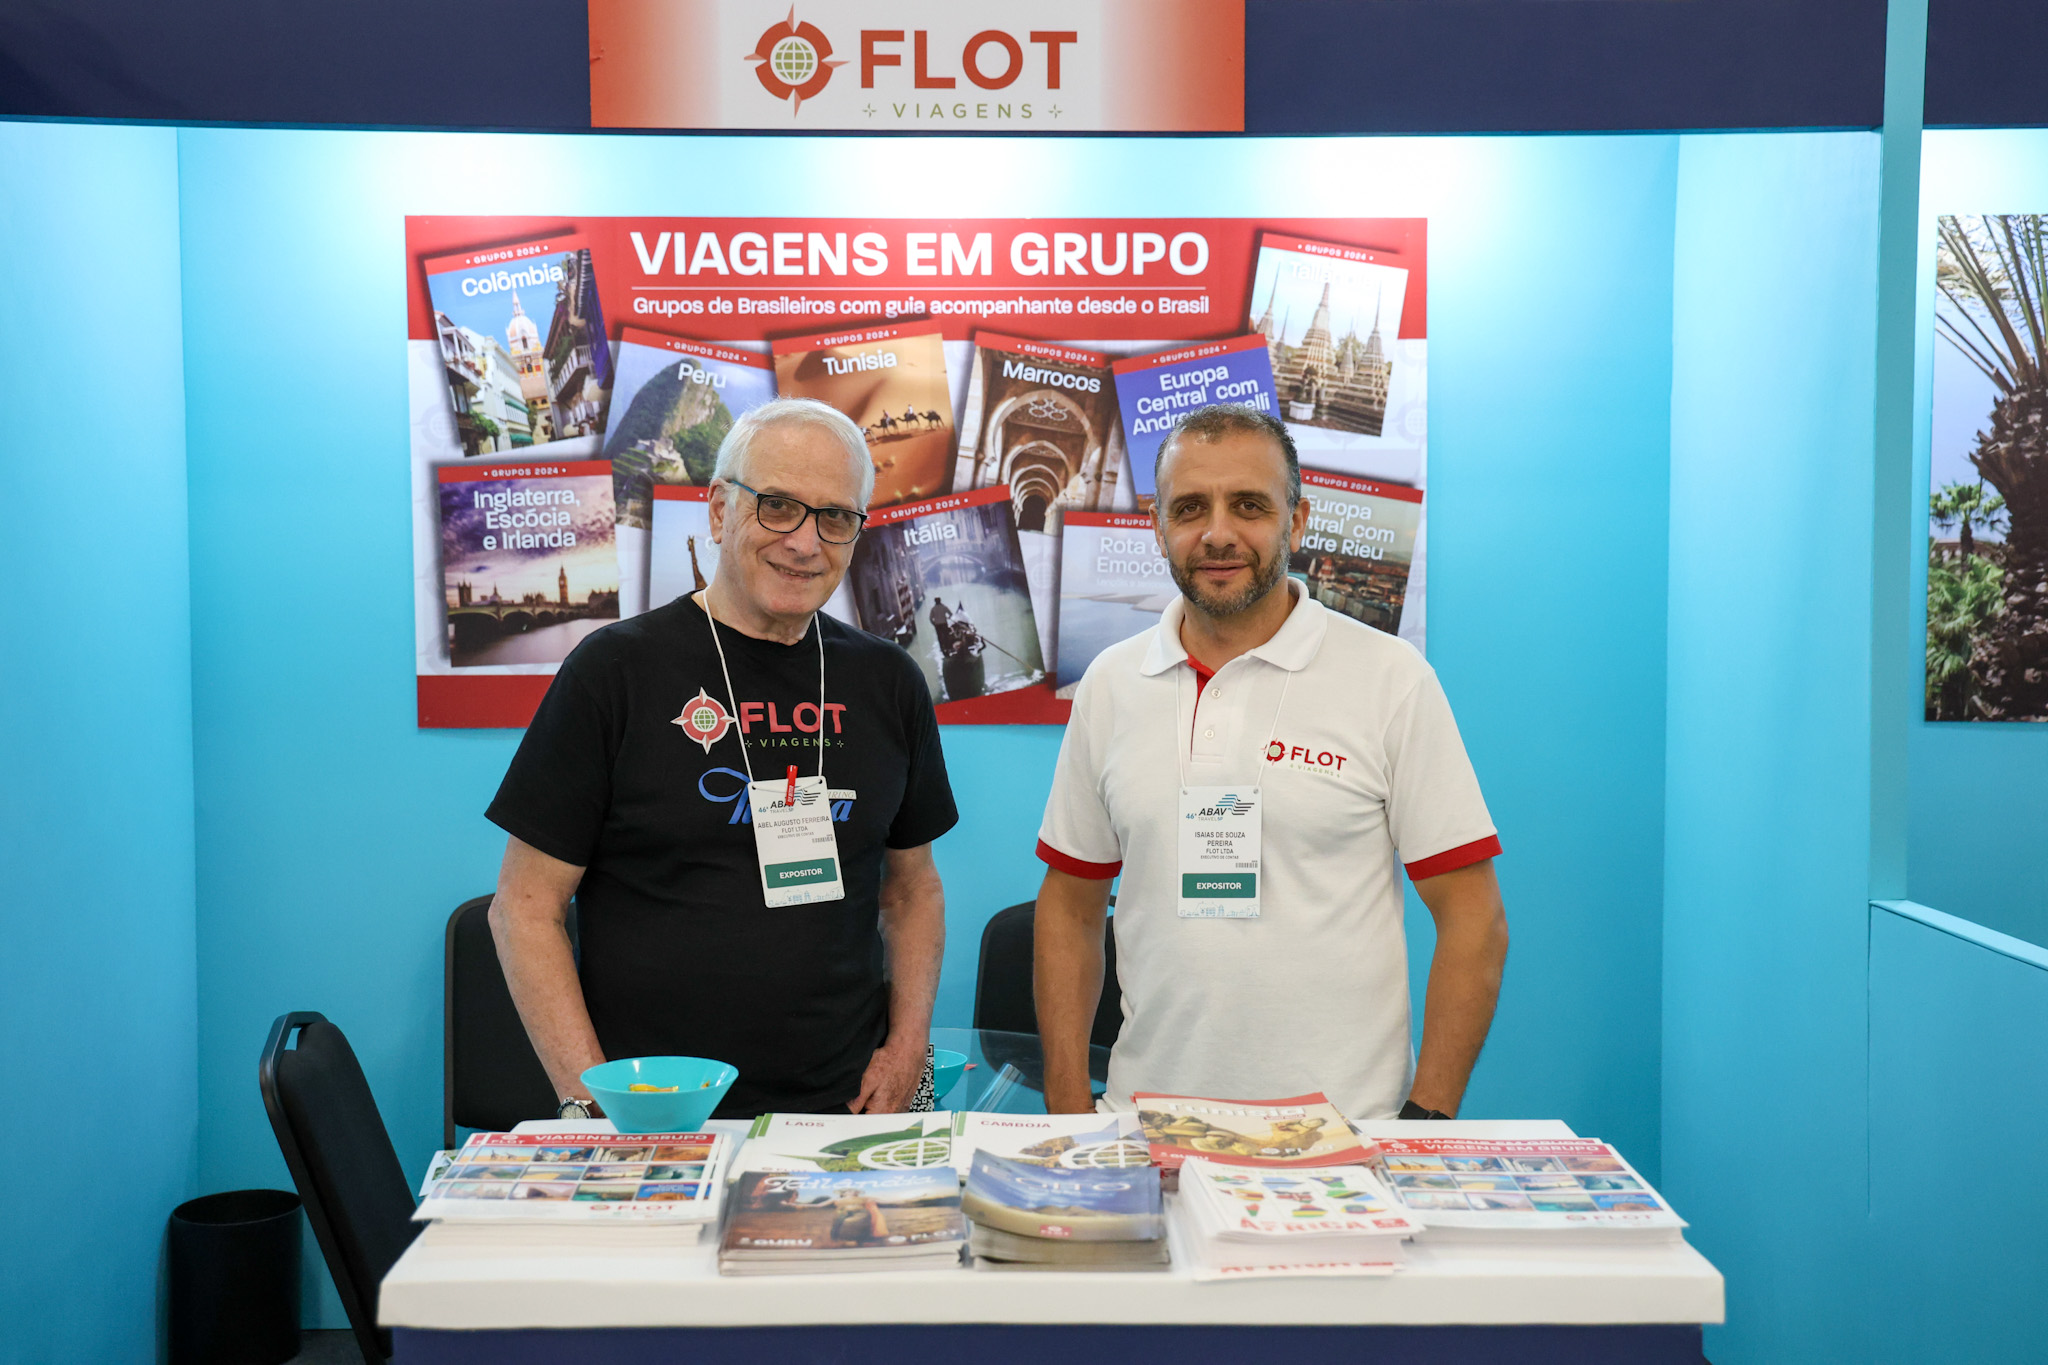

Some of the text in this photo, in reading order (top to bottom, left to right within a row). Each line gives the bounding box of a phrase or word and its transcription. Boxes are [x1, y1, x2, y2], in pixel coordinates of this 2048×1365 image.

[859, 29, 1078, 91] FLOT
[892, 103, 1034, 119] VIAGENS
[474, 245, 541, 264] GRUPOS 2024
[630, 231, 1210, 277] VIAGENS EM GRUPO
[1304, 244, 1367, 261] GRUPOS 2024
[461, 262, 564, 297] Colômbia
[633, 296, 1209, 319] Grupos de Brasileiros com guia acompanhante desde o Brasil
[823, 329, 890, 346] GRUPOS 2024
[673, 341, 741, 362] GRUPOS 2024
[1024, 344, 1089, 362] GRUPOS 2024
[1159, 345, 1221, 364] GRUPOS 2024
[822, 349, 898, 376] Tunísia
[677, 362, 727, 389] Peru
[1002, 359, 1101, 393] Marrocos
[1159, 365, 1229, 392] Europa
[1136, 378, 1259, 415] Central com
[491, 466, 559, 478] GRUPOS 2024
[1312, 475, 1373, 493] GRUPOS 2024
[473, 487, 581, 513] Inglaterra,
[890, 498, 961, 518] GRUPOS 2024
[1306, 494, 1372, 522] Europa
[485, 509, 571, 530] Escócia
[1113, 517, 1152, 527] GRUPOS
[1307, 514, 1395, 543] ntral com
[482, 528, 577, 550] e Irlanda
[903, 520, 958, 547] Itália
[1100, 536, 1146, 555] Rota
[1341, 538, 1385, 560] Rieu
[739, 701, 847, 735] FLOT
[760, 738, 832, 748] VIAGENS
[1290, 746, 1347, 771] FLOT
[1198, 807, 1228, 816] ABAV
[757, 815, 830, 829] ABEL AUGUSTO FERREIRA
[779, 867, 823, 880] EXPOSITOR
[1196, 882, 1242, 891] EXPOSITOR
[785, 1120, 826, 1128] LAOS
[980, 1119, 1052, 1128] CAMBOJA
[534, 1134, 709, 1142] VIAGENS EM GRUPO
